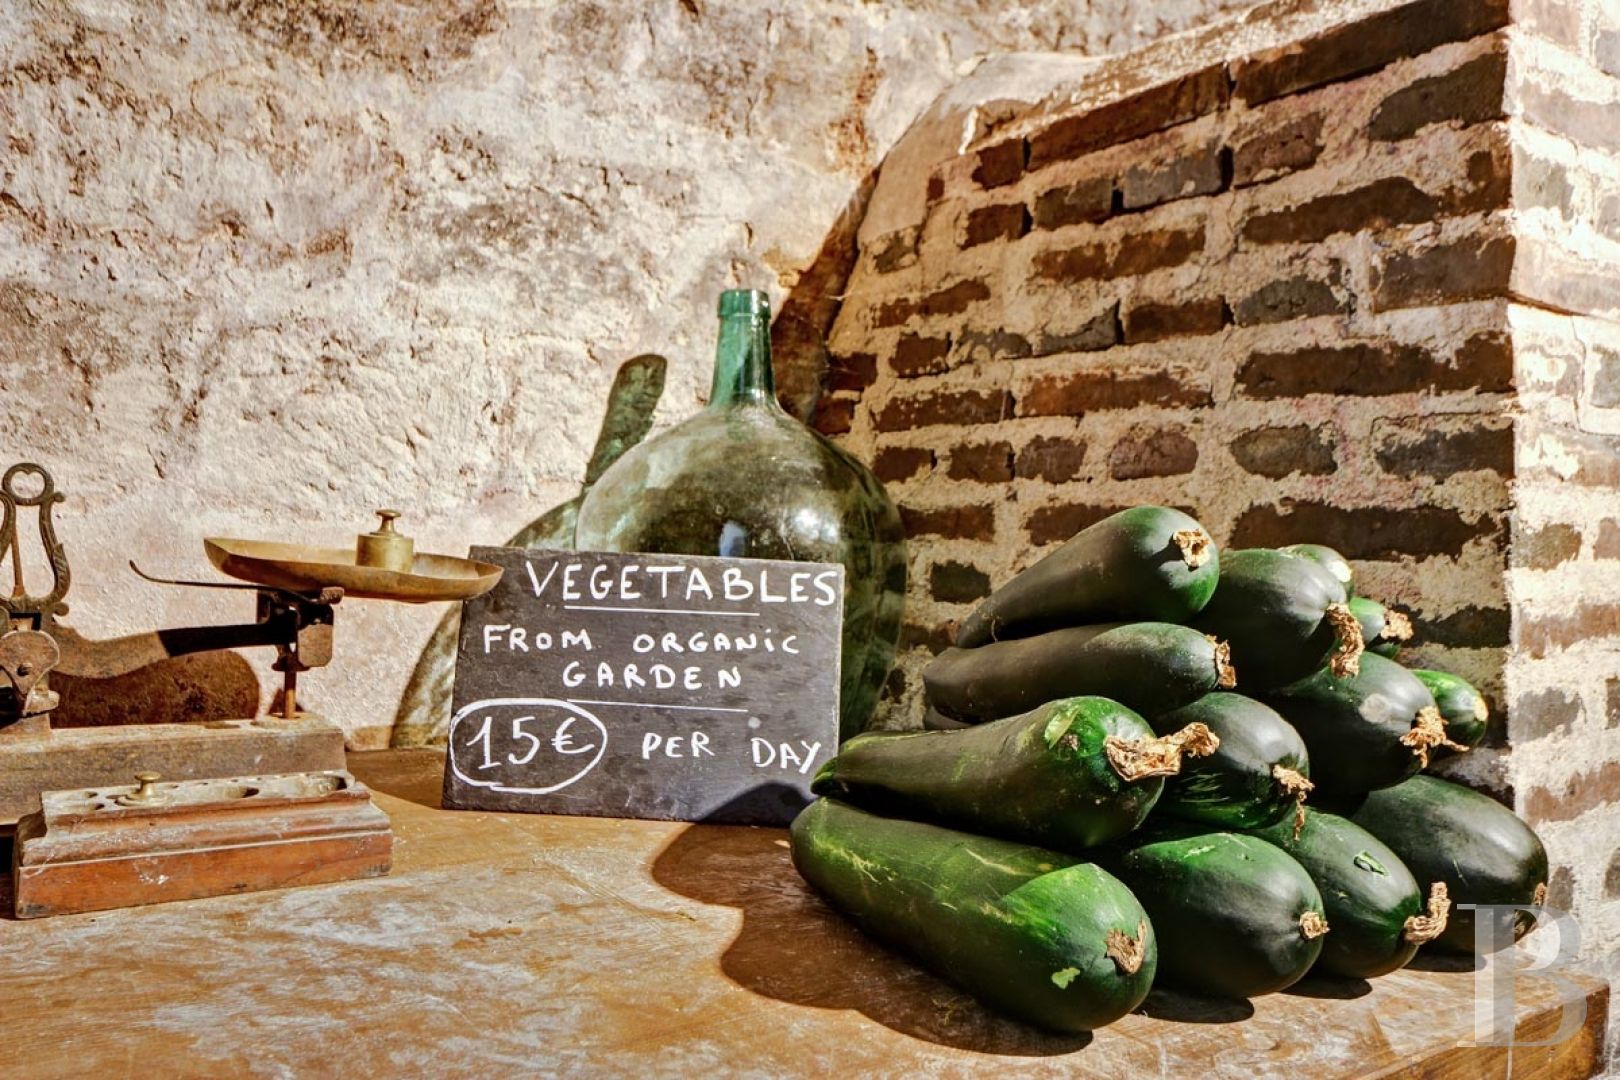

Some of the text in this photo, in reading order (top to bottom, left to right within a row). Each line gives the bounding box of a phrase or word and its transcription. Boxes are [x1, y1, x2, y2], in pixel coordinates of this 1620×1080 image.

[526, 561, 839, 606] VEGETABLES
[483, 624, 592, 654] FROM
[562, 661, 742, 690] GARDEN
[466, 715, 821, 774] 15€ PER DAY
